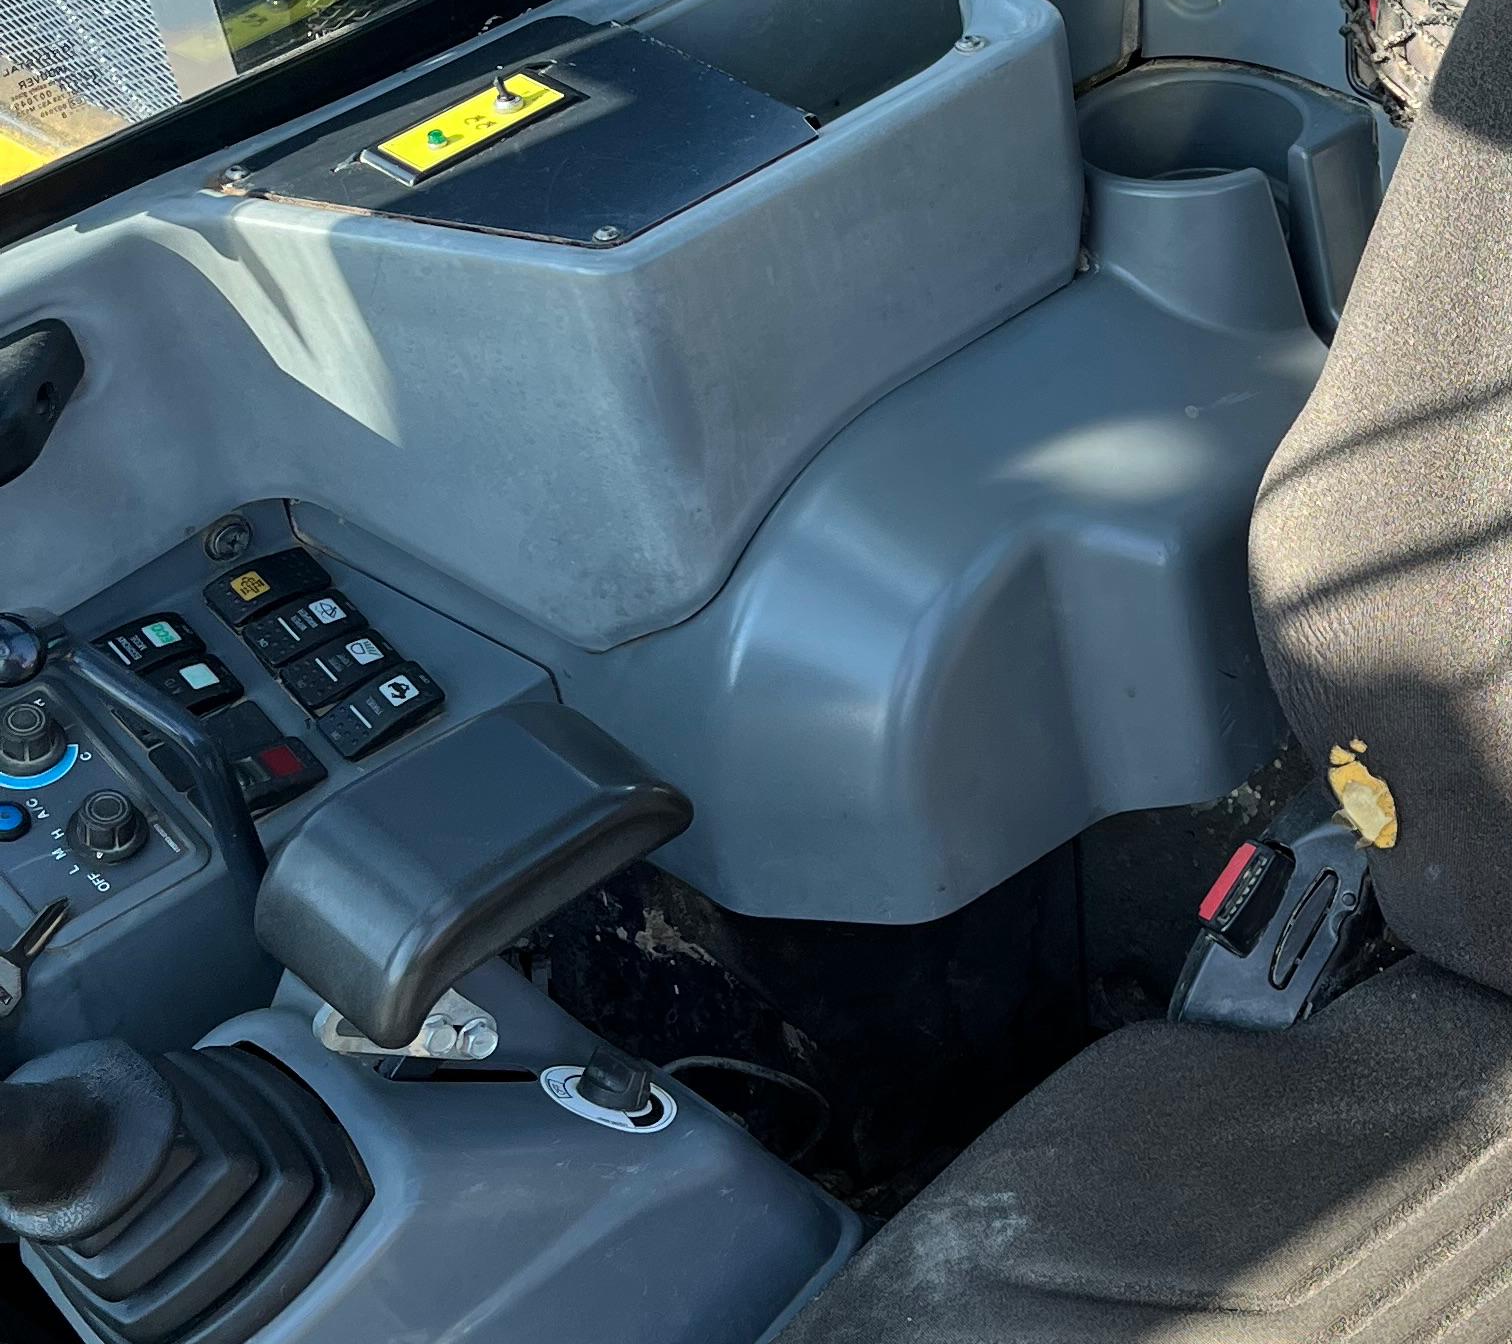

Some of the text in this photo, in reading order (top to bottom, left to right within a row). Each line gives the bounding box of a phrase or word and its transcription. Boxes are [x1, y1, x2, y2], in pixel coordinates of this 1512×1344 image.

[151, 624, 174, 643] ECO
[80, 751, 92, 761] C
[26, 798, 50, 820] A/C
[51, 828, 110, 892] OFF L M H
